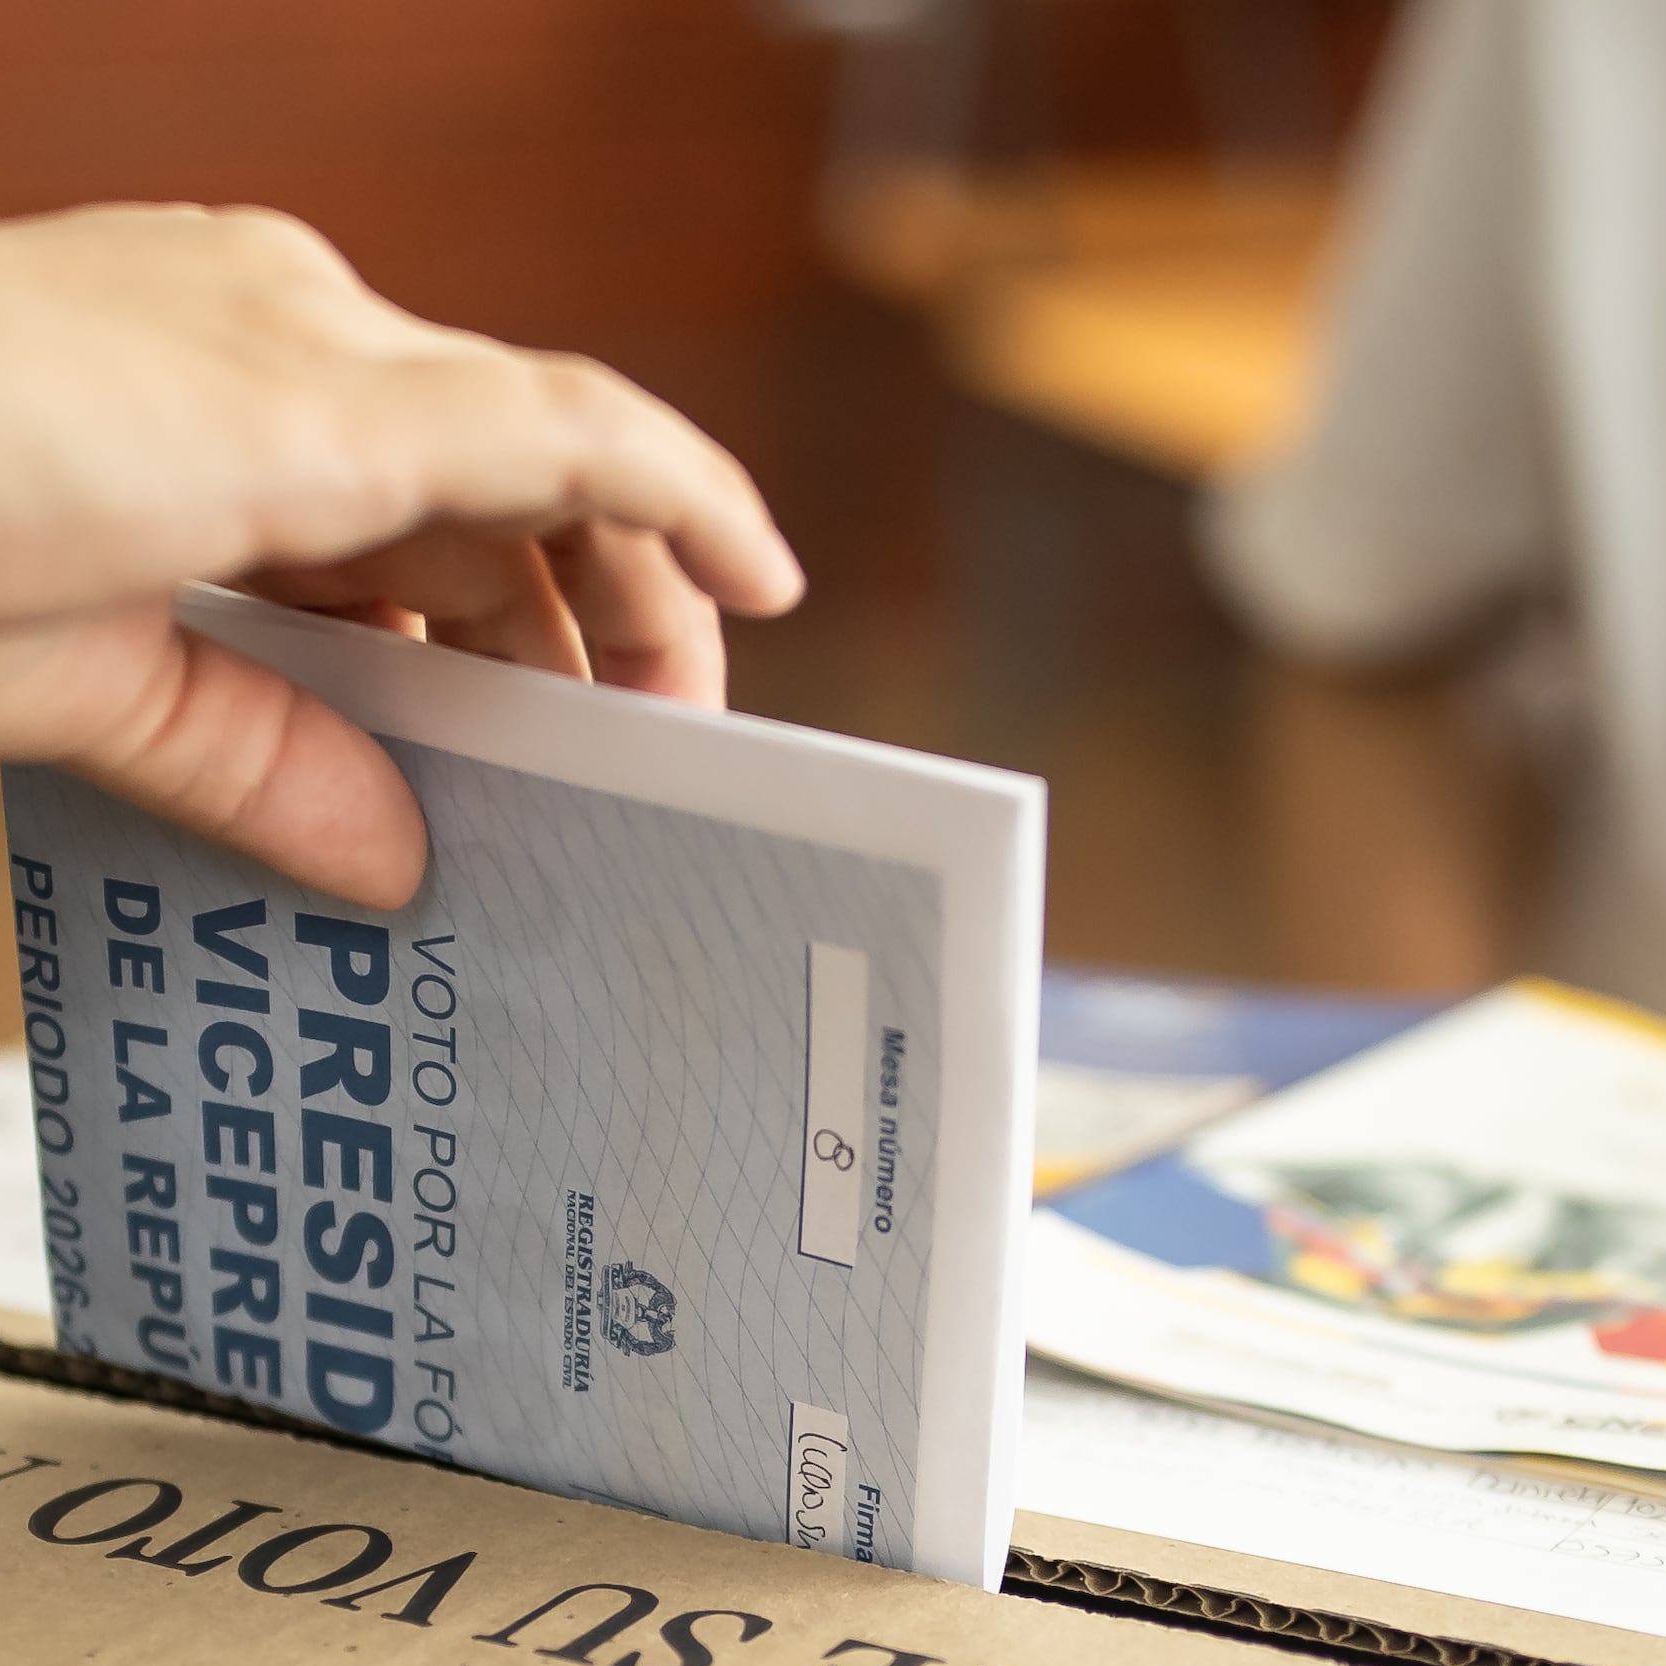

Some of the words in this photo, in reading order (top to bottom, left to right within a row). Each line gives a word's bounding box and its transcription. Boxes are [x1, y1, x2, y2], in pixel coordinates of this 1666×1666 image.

[103, 877, 165, 995] DE
[11, 853, 78, 1156] PERIODO
[410, 933, 459, 1107] VOTO
[112, 1018, 174, 1124] LA
[880, 1024, 906, 1107] Mesa
[191, 898, 283, 1402] VICEPRE
[294, 911, 397, 1437] PRESID
[412, 1124, 457, 1261] POR
[813, 1127, 855, 1172] 8
[874, 1115, 904, 1234] número
[121, 1151, 200, 1372] REPÚ
[563, 1263, 576, 1291] DEL
[564, 1188, 577, 1259] NACIONAL
[412, 1272, 456, 1344] LA
[563, 1295, 576, 1351] ESTADO
[573, 1193, 595, 1393] REGISTRADURÍA
[561, 1352, 574, 1391] CIVIL
[28, 1477, 480, 1628] VOTO
